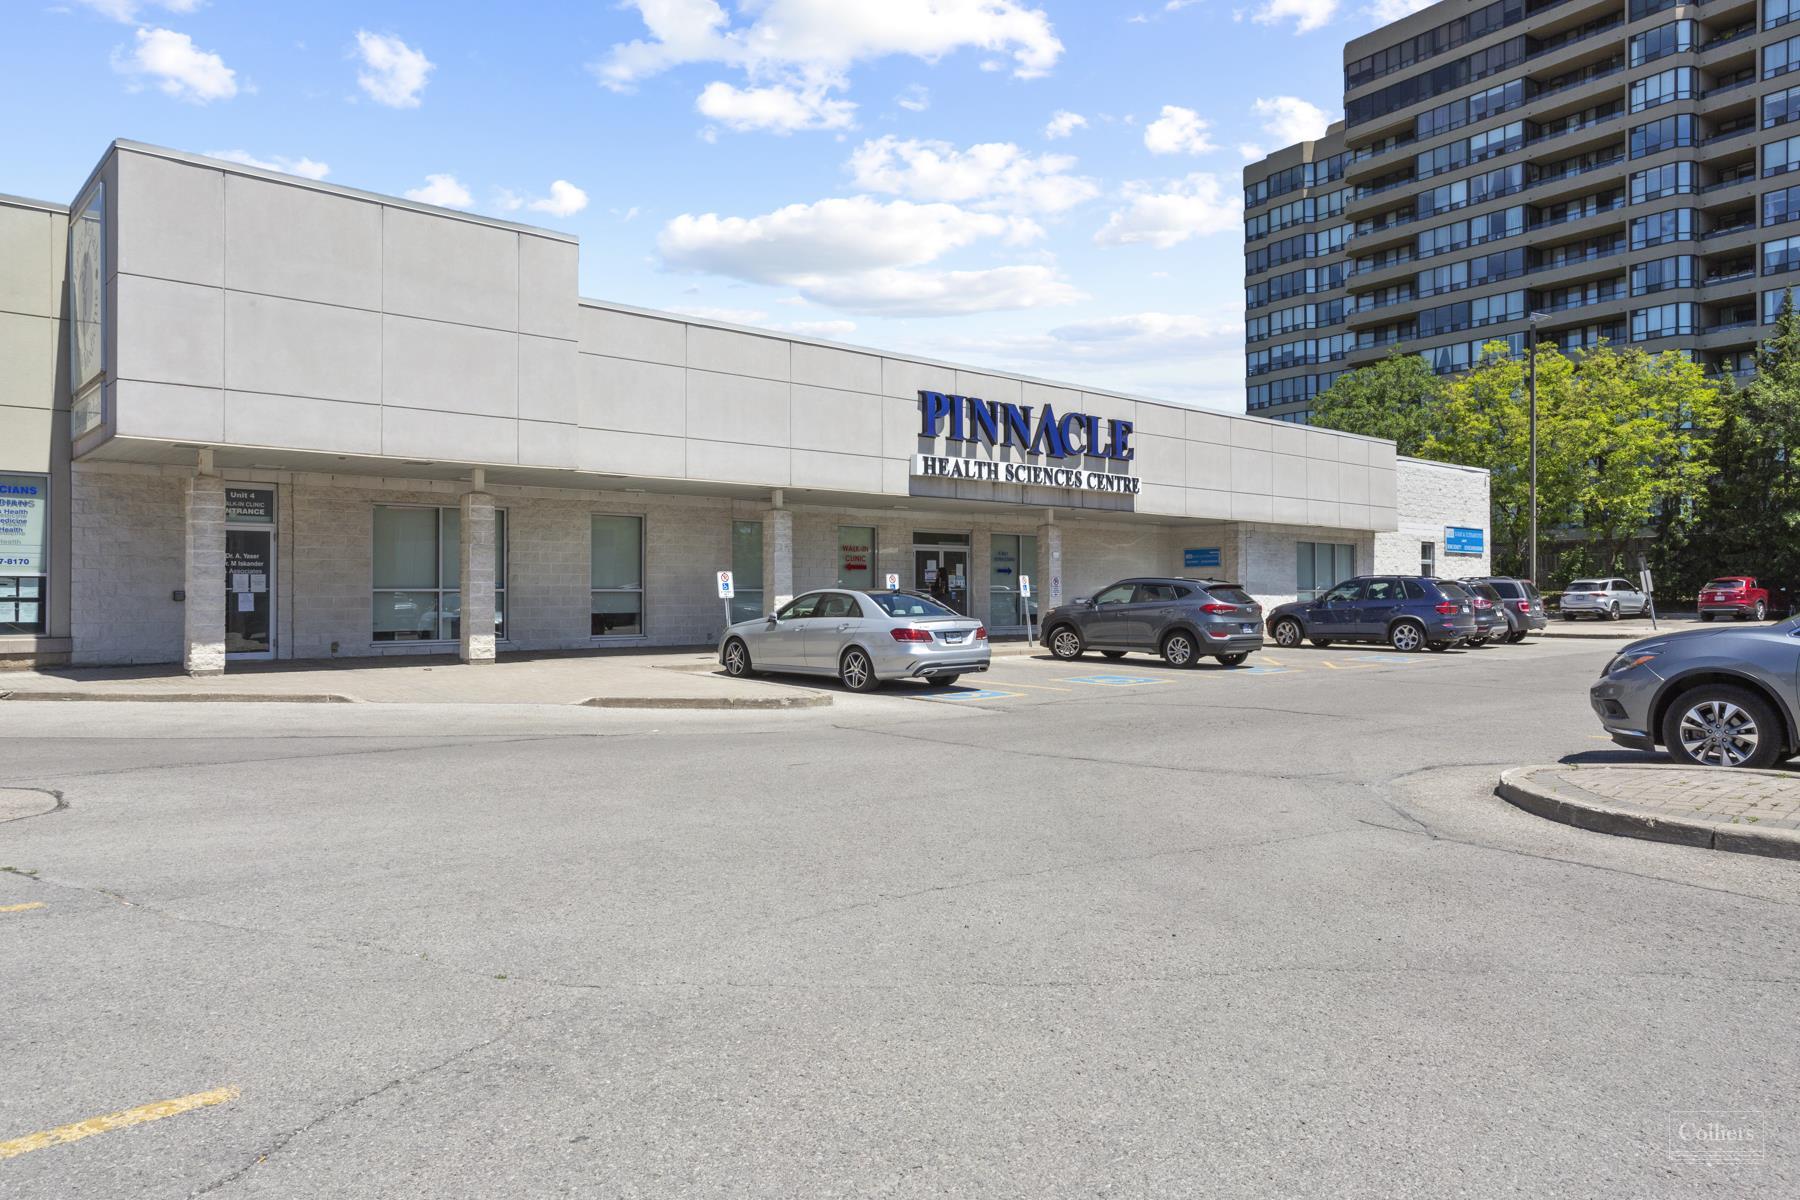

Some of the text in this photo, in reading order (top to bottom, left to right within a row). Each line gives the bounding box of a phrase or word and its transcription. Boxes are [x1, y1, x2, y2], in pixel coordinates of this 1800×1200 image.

[918, 390, 1134, 460] PINNACLE
[923, 456, 1140, 494] HEALTH SCIENCES CENTRE
[842, 544, 869, 552] WALK-IN
[845, 554, 866, 562] CLINIC
